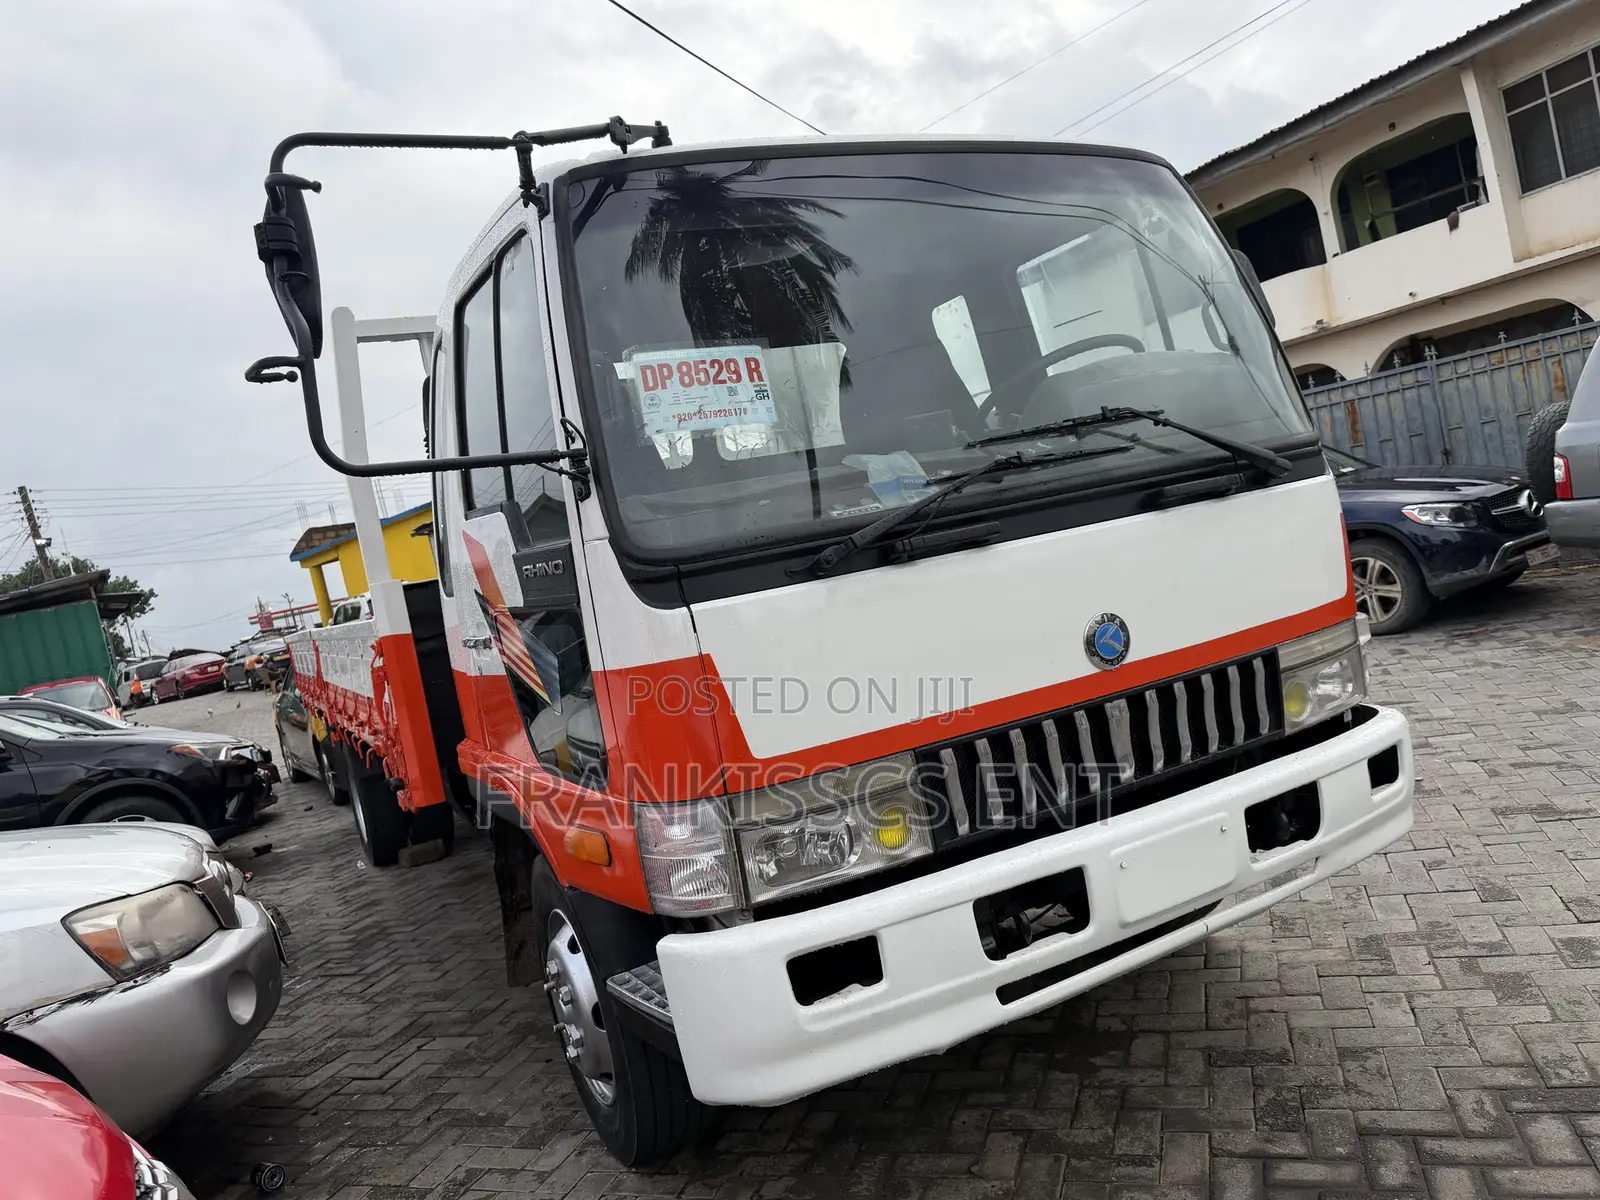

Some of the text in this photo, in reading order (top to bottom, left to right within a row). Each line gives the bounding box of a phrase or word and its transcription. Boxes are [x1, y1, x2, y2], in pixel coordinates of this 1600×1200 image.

[640, 356, 764, 392] DP 8529 R
[755, 392, 770, 401] GH
[522, 559, 564, 579] RHINO
